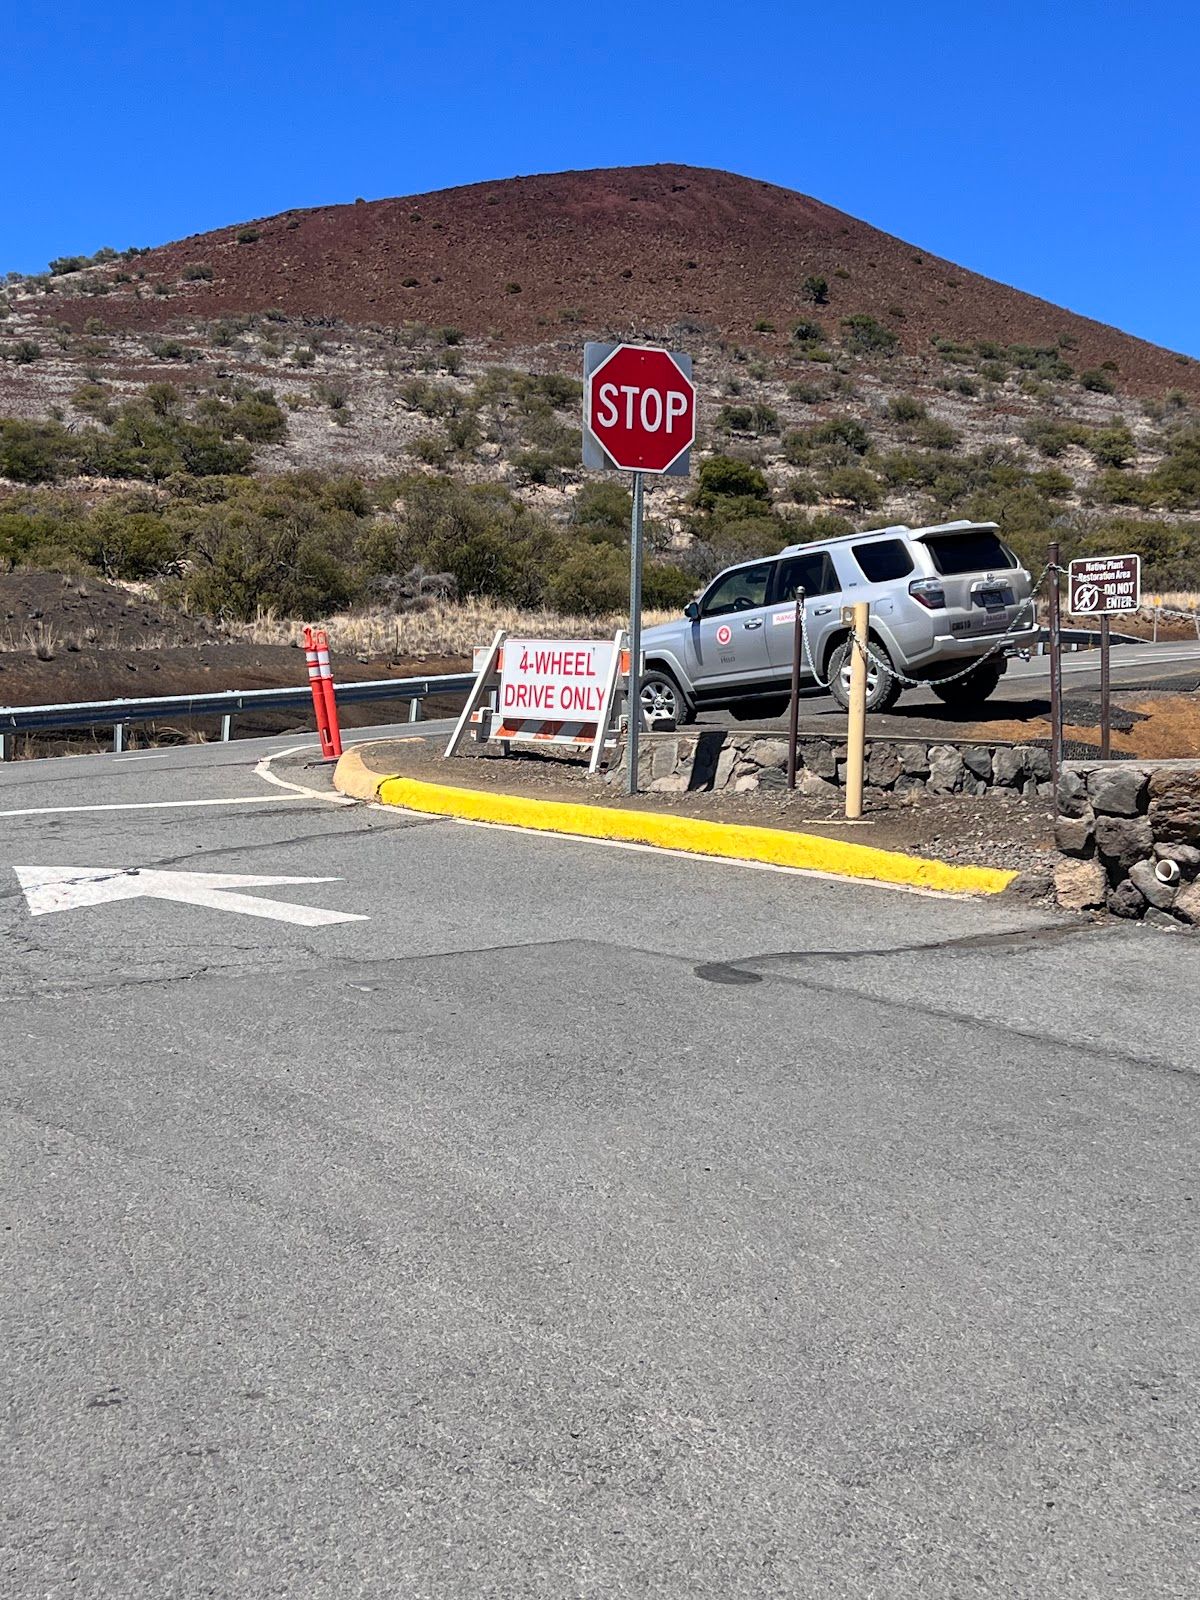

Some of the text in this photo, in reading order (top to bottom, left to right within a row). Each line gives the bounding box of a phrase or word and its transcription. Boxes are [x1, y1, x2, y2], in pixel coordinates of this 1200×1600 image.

[597, 383, 688, 433] STOP
[1085, 560, 1124, 571] Native Plant
[1078, 570, 1131, 582] Restoration Area
[1104, 582, 1135, 595] DO NOT
[1106, 596, 1132, 608] ENTER
[520, 651, 596, 676] 4-WHEEL
[505, 684, 605, 711] DRIVE ONLY
